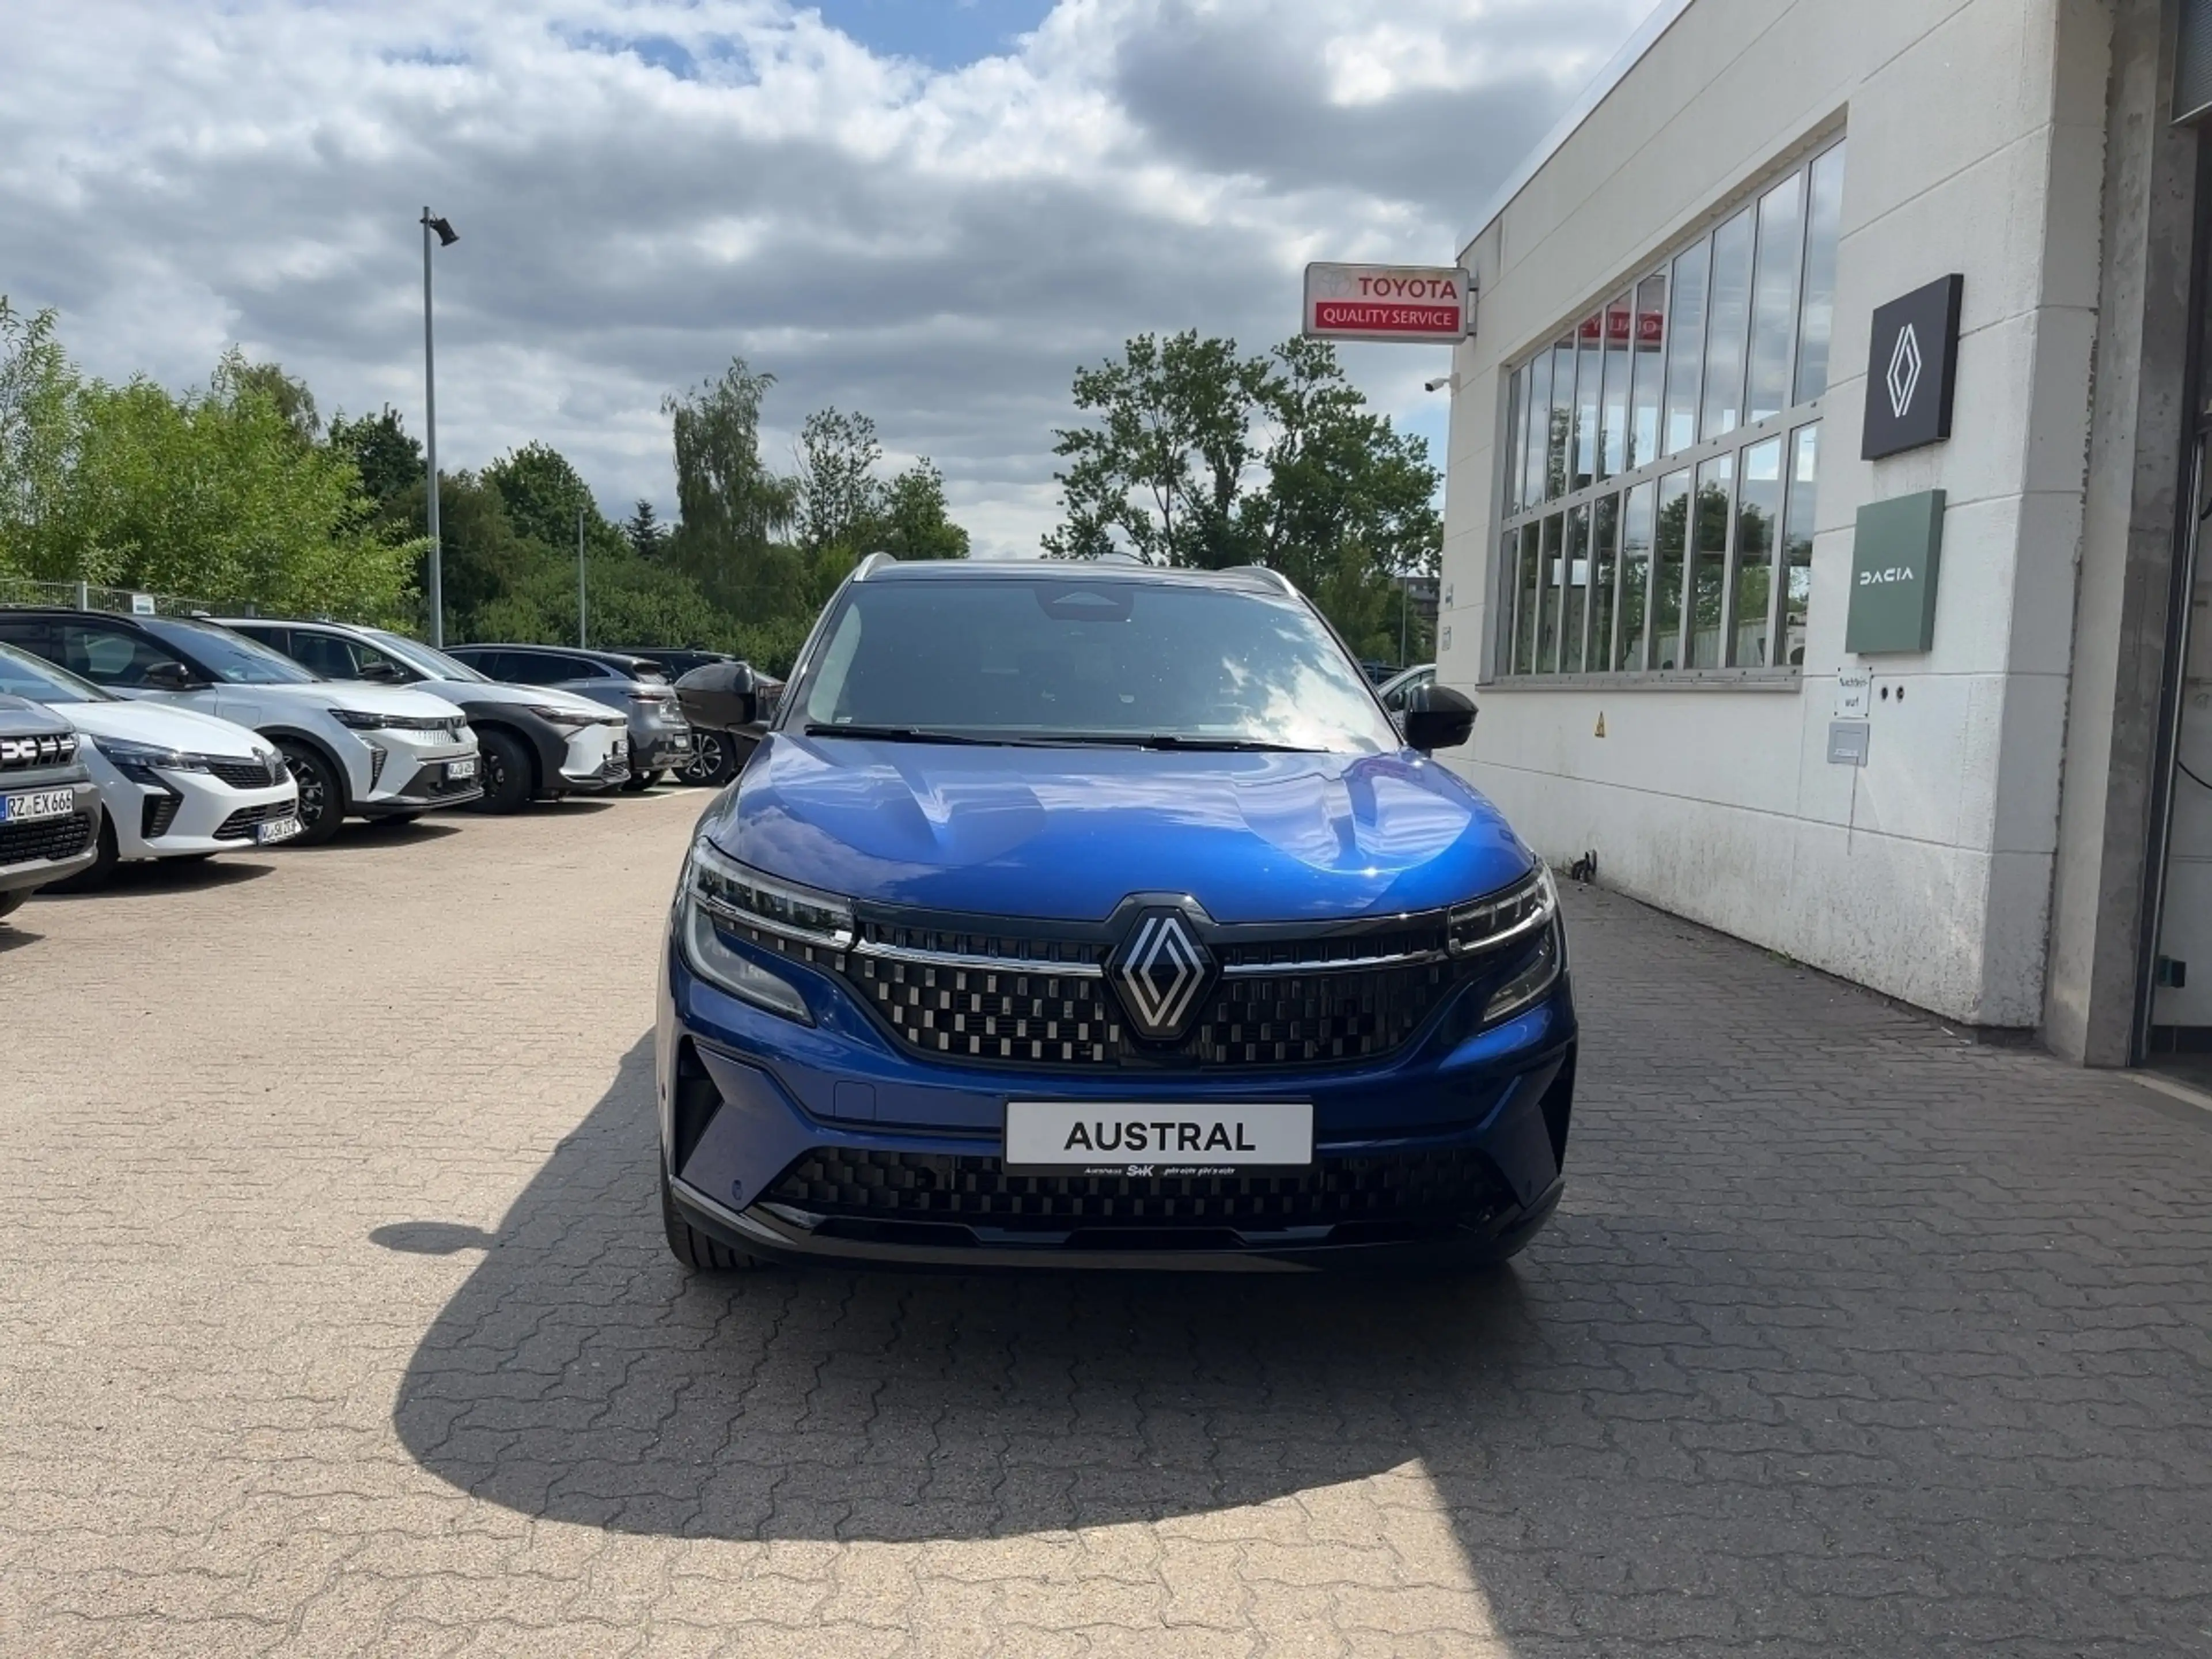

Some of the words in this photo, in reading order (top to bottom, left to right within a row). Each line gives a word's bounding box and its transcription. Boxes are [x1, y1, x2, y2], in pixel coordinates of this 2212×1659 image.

[1358, 278, 1457, 300] TOYOTA
[1323, 308, 1389, 324] QUALITY
[1392, 310, 1452, 325] SERVICE
[1859, 567, 1914, 585] DACIA
[7, 796, 25, 817] RZ
[1063, 1122, 1256, 1151] AUSTRAL
